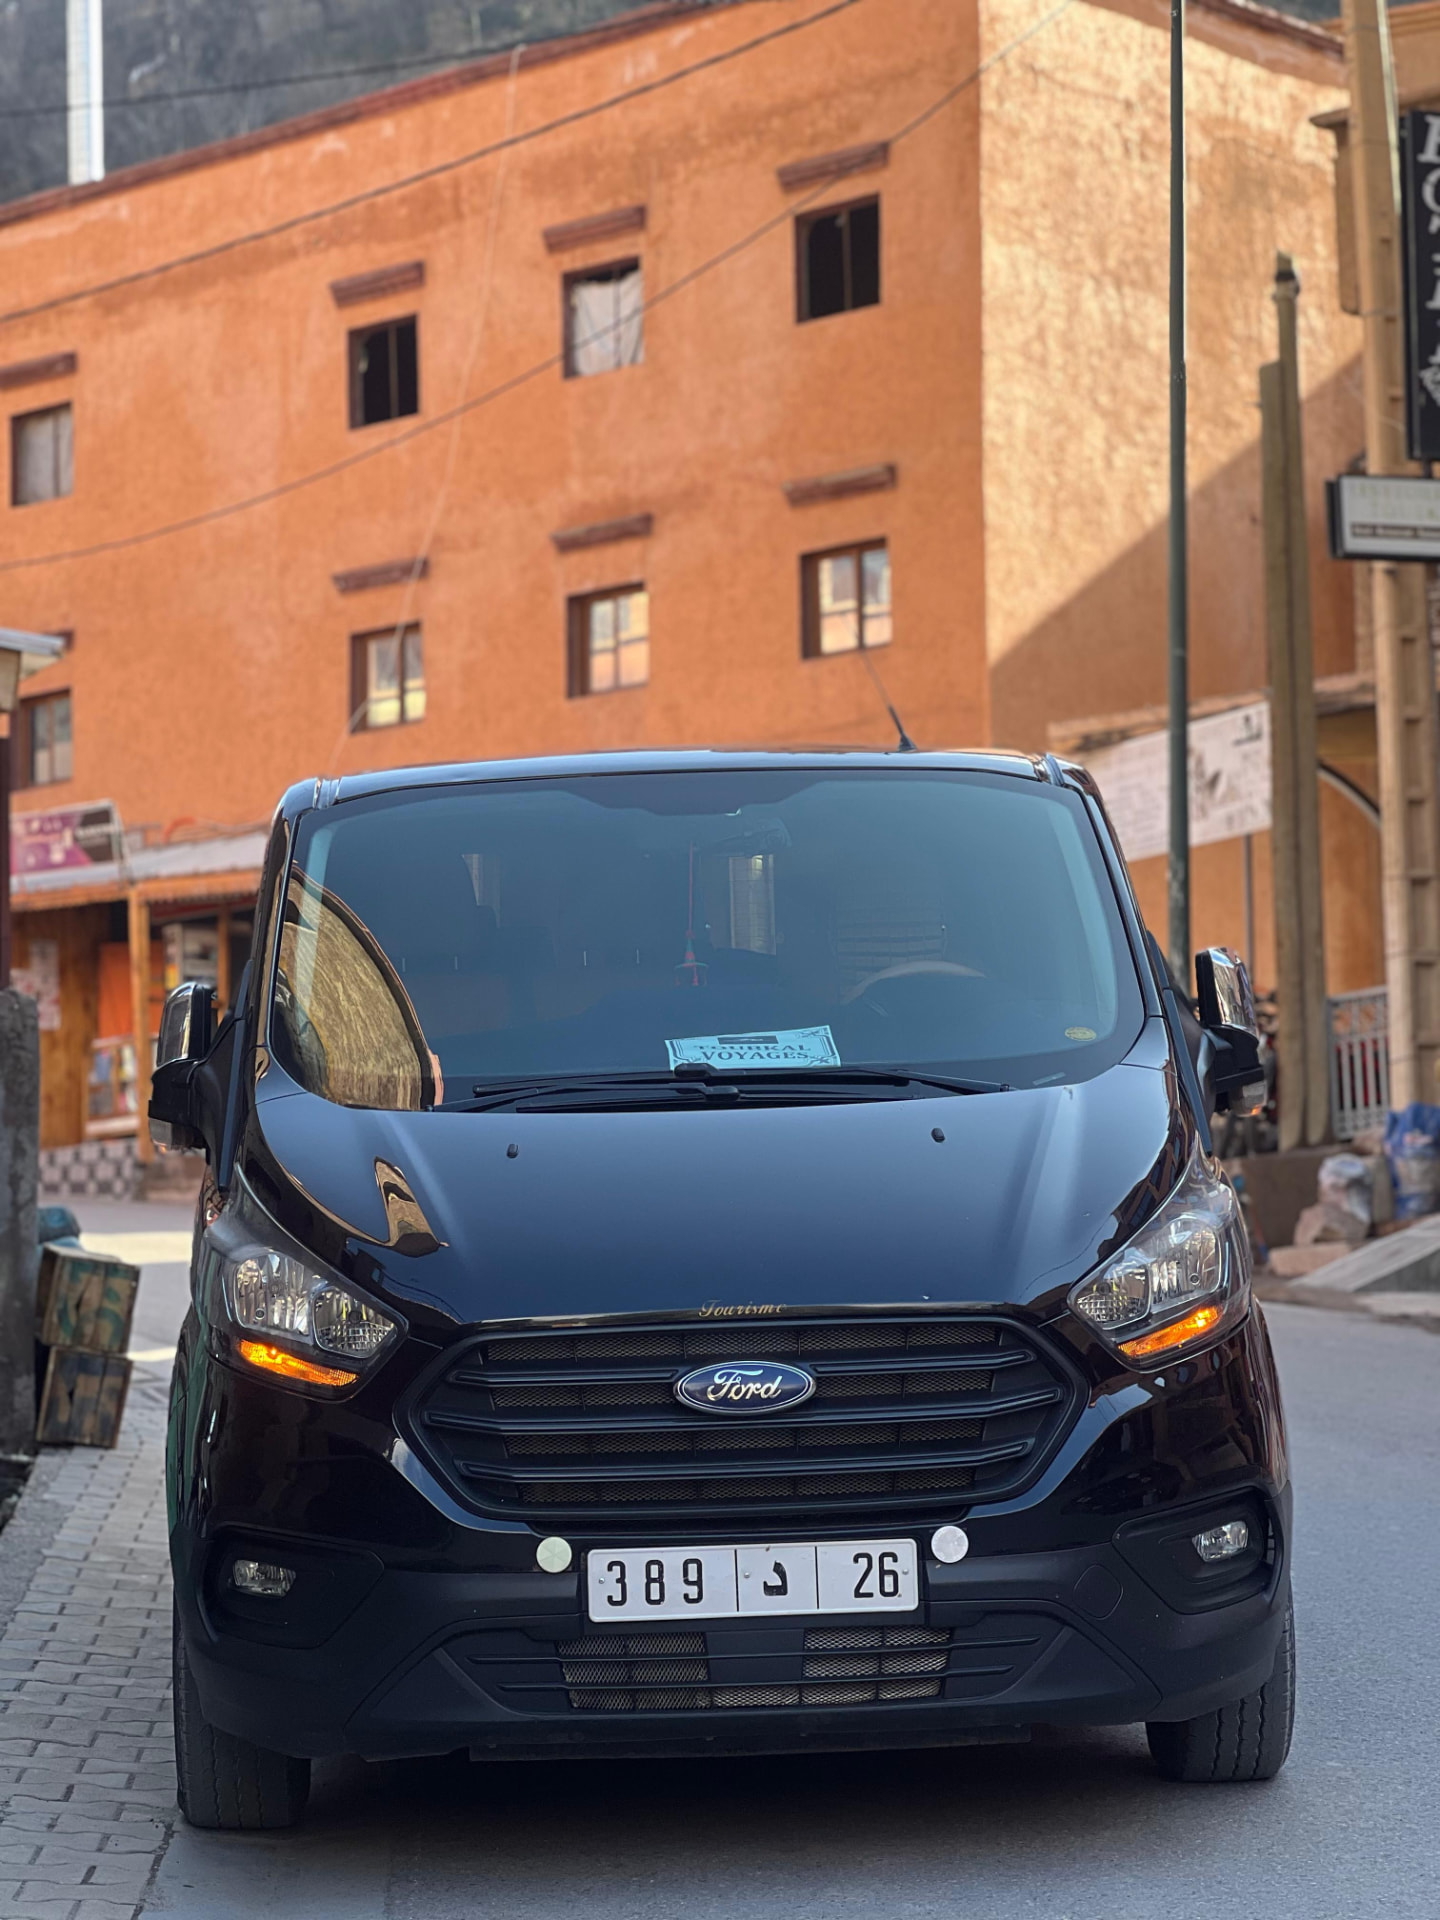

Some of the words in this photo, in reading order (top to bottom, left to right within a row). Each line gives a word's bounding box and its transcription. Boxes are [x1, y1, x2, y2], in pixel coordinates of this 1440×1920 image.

[701, 1051, 809, 1061] VOYAGES
[706, 1369, 783, 1401] Ford
[606, 1558, 704, 1607] 389
[852, 1551, 899, 1599] 26
